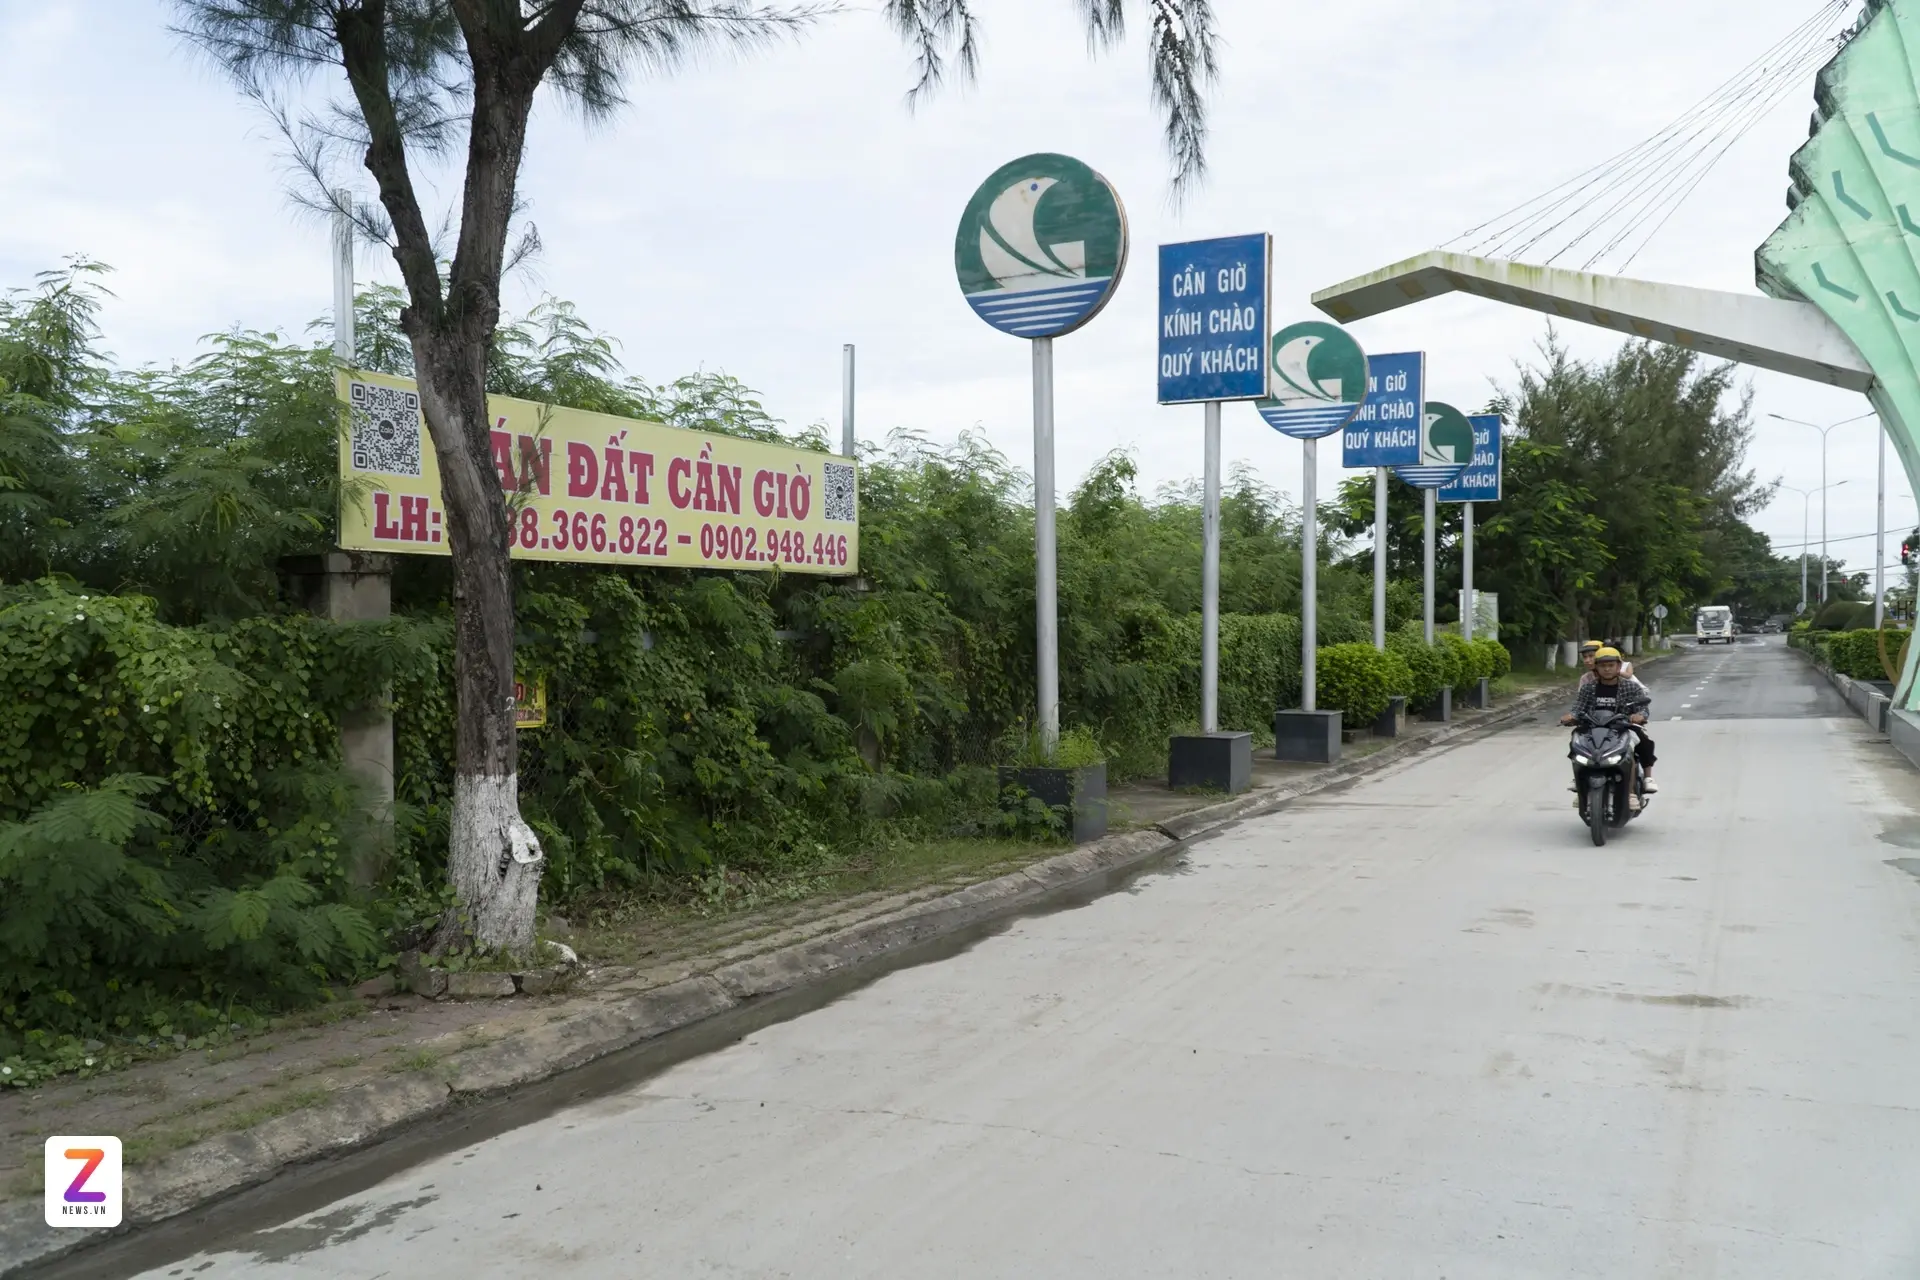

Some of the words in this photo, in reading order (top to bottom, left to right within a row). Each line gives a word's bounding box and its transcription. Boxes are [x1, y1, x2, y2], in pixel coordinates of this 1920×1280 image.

[1172, 264, 1205, 298] CẦN
[1218, 261, 1247, 293] GIỜ
[1164, 308, 1201, 338] KÍNH
[1208, 302, 1255, 334] CHÀO
[1162, 347, 1193, 378] QUÝ
[1201, 344, 1258, 374] KHÁCH
[1385, 369, 1407, 392] GIỜ
[1381, 398, 1415, 420] CHÀO
[1345, 428, 1370, 449] QUÝ
[1374, 426, 1416, 448] KHÁCH
[489, 417, 552, 496] ÁN
[567, 430, 654, 505] ĐẤT
[667, 441, 742, 515] CẦN
[753, 463, 812, 521] GIỜ
[1463, 472, 1496, 488] KHÁCH
[374, 492, 441, 542] LH:
[700, 523, 848, 566] 0902.948.446
